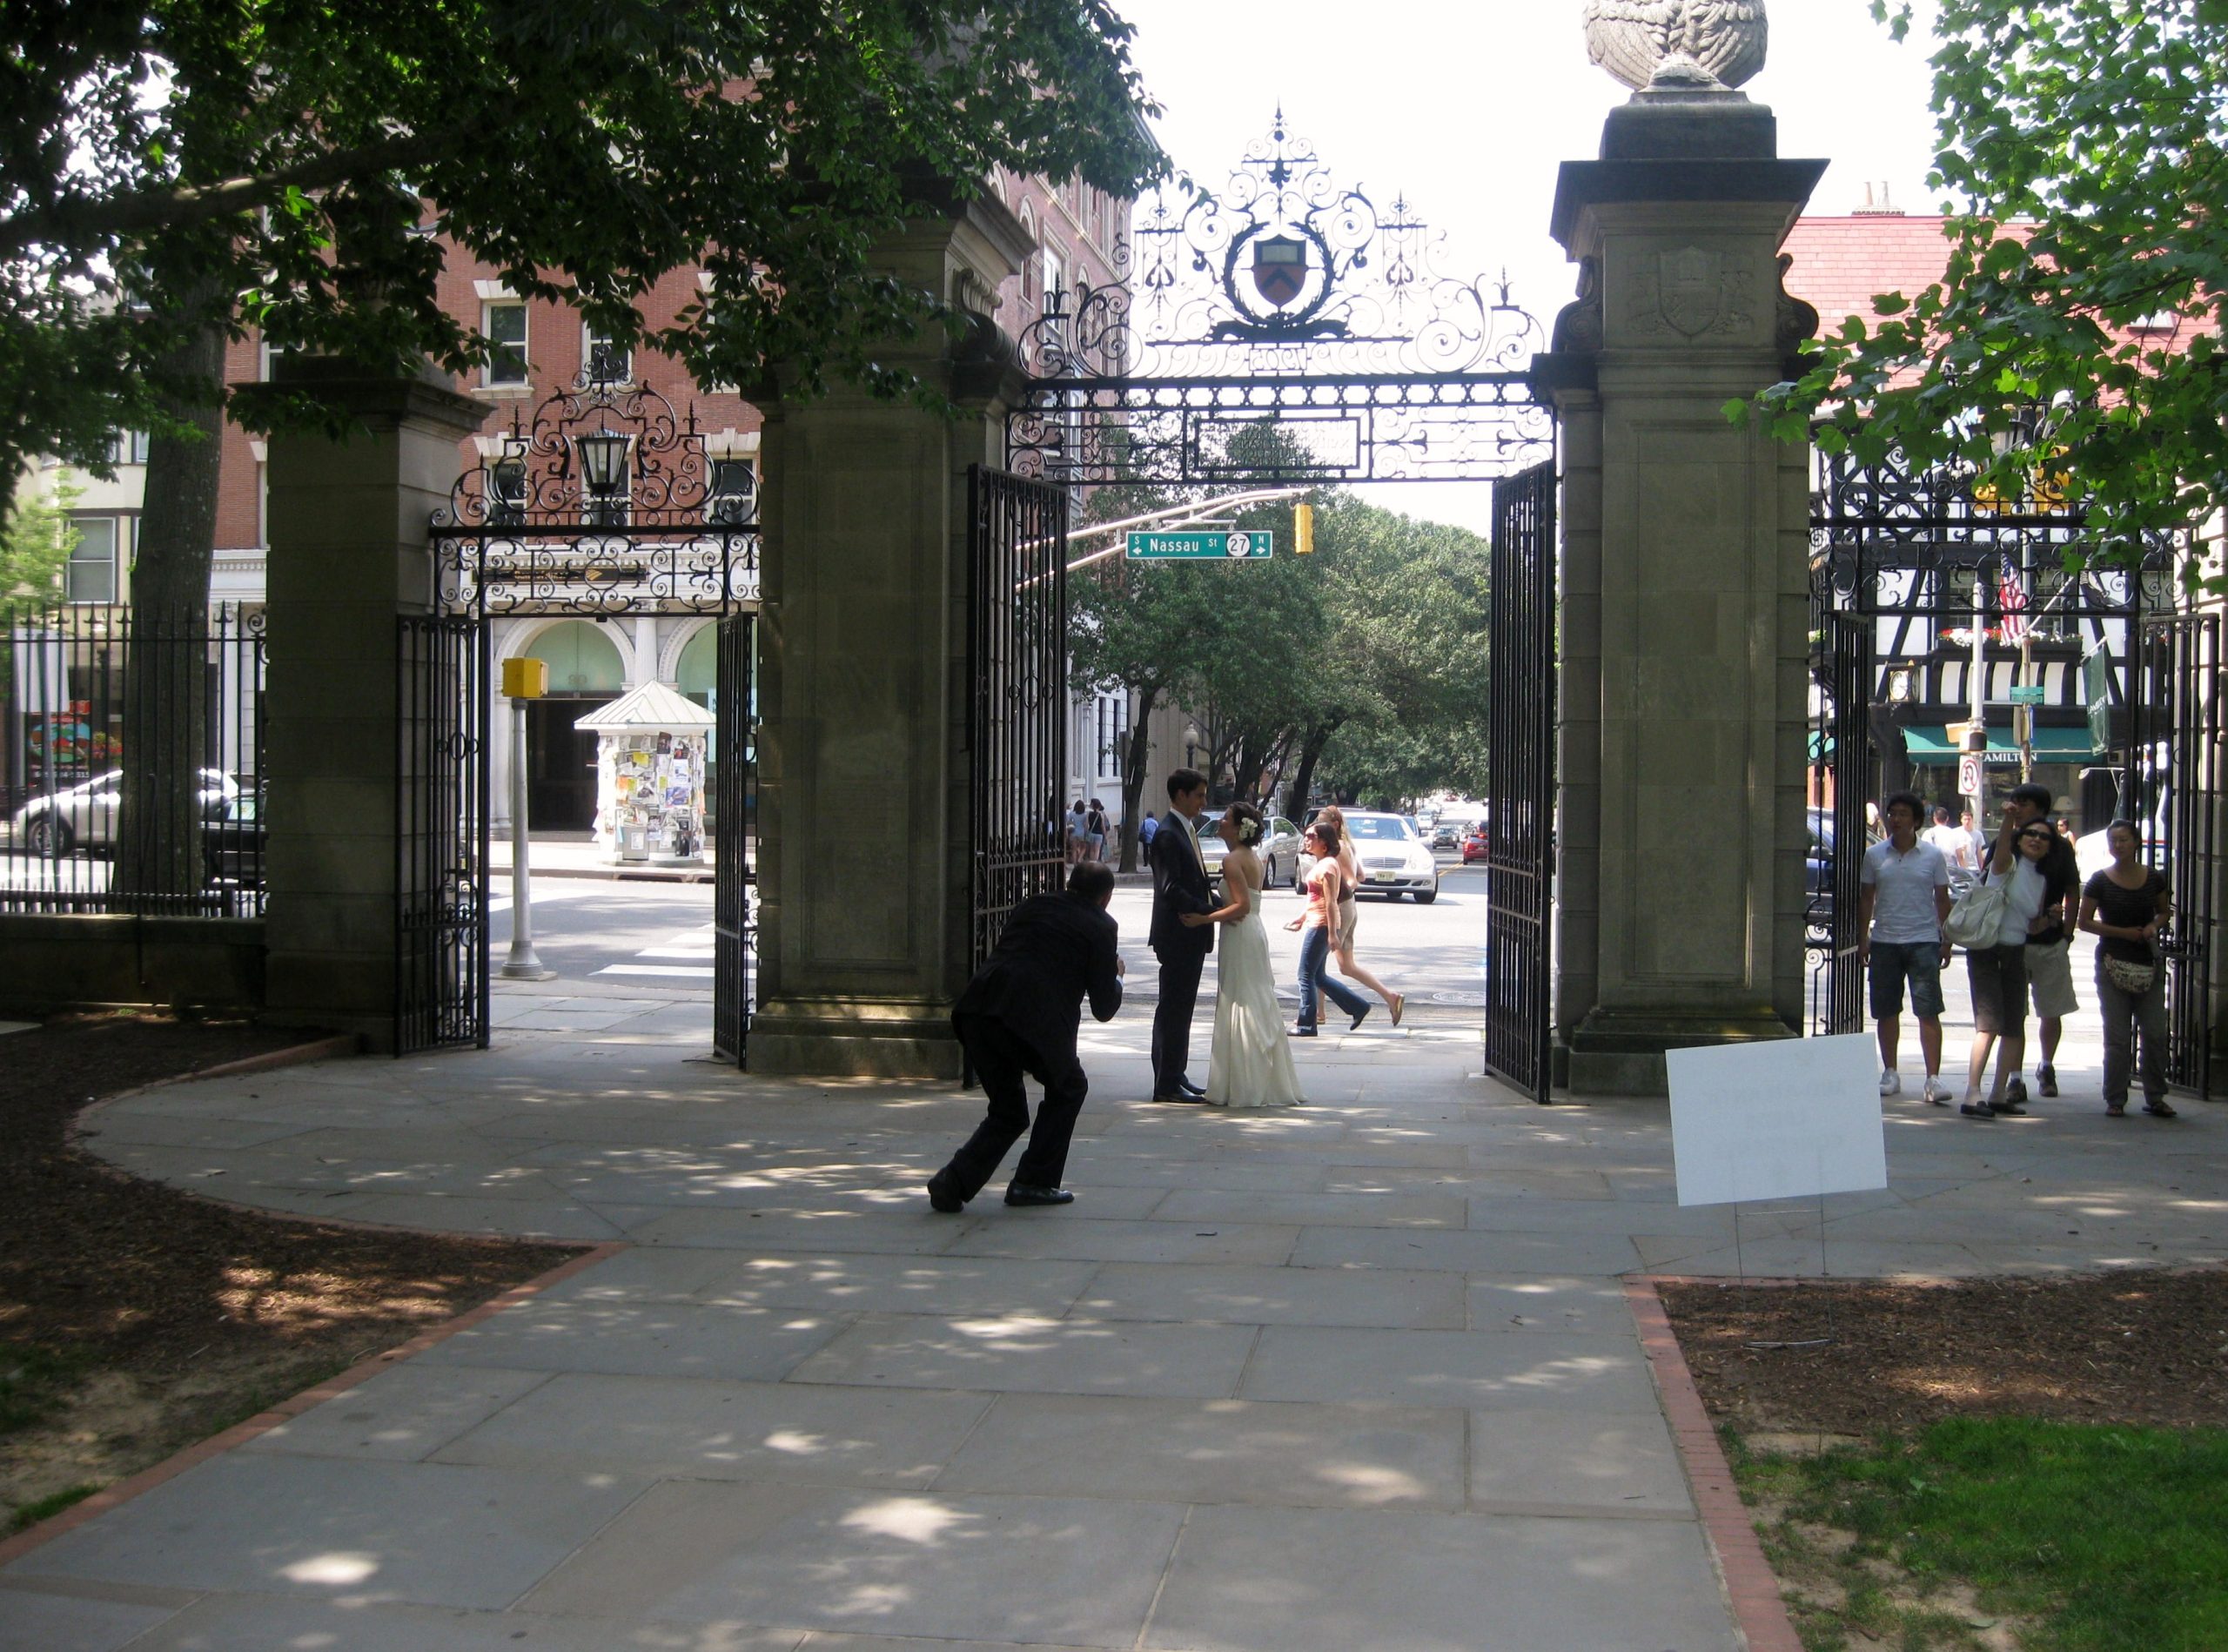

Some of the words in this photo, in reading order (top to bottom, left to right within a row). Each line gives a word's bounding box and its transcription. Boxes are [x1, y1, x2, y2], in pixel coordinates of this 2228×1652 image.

[1134, 535, 1140, 544] S
[1258, 535, 1265, 544] N
[1150, 538, 1199, 552] Nassau
[1208, 539, 1218, 547] St
[1230, 538, 1246, 552] 27
[1983, 752, 2037, 762] AMILTN
